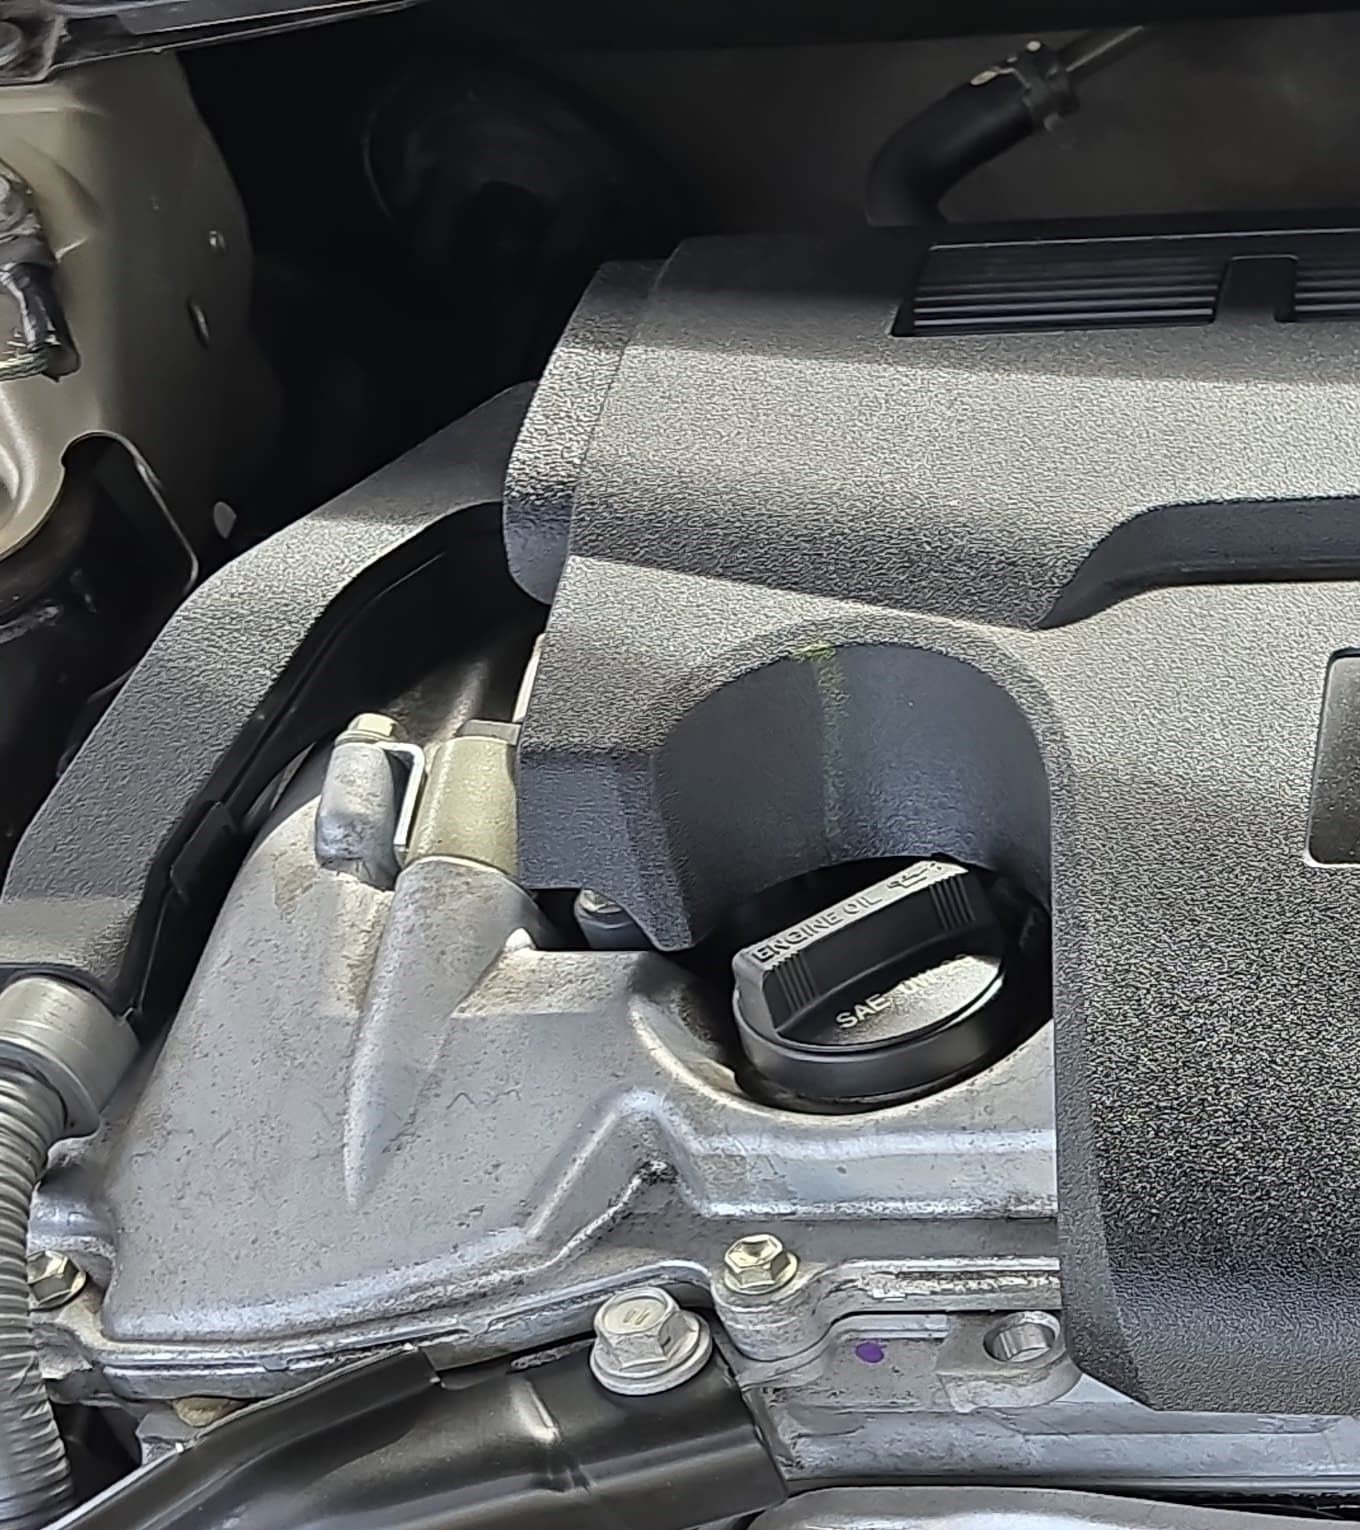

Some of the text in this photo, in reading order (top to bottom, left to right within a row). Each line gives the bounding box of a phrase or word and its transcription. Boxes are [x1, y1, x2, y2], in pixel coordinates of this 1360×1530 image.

[752, 895, 883, 962] ENGINE OIL
[836, 993, 890, 1029] SAE
